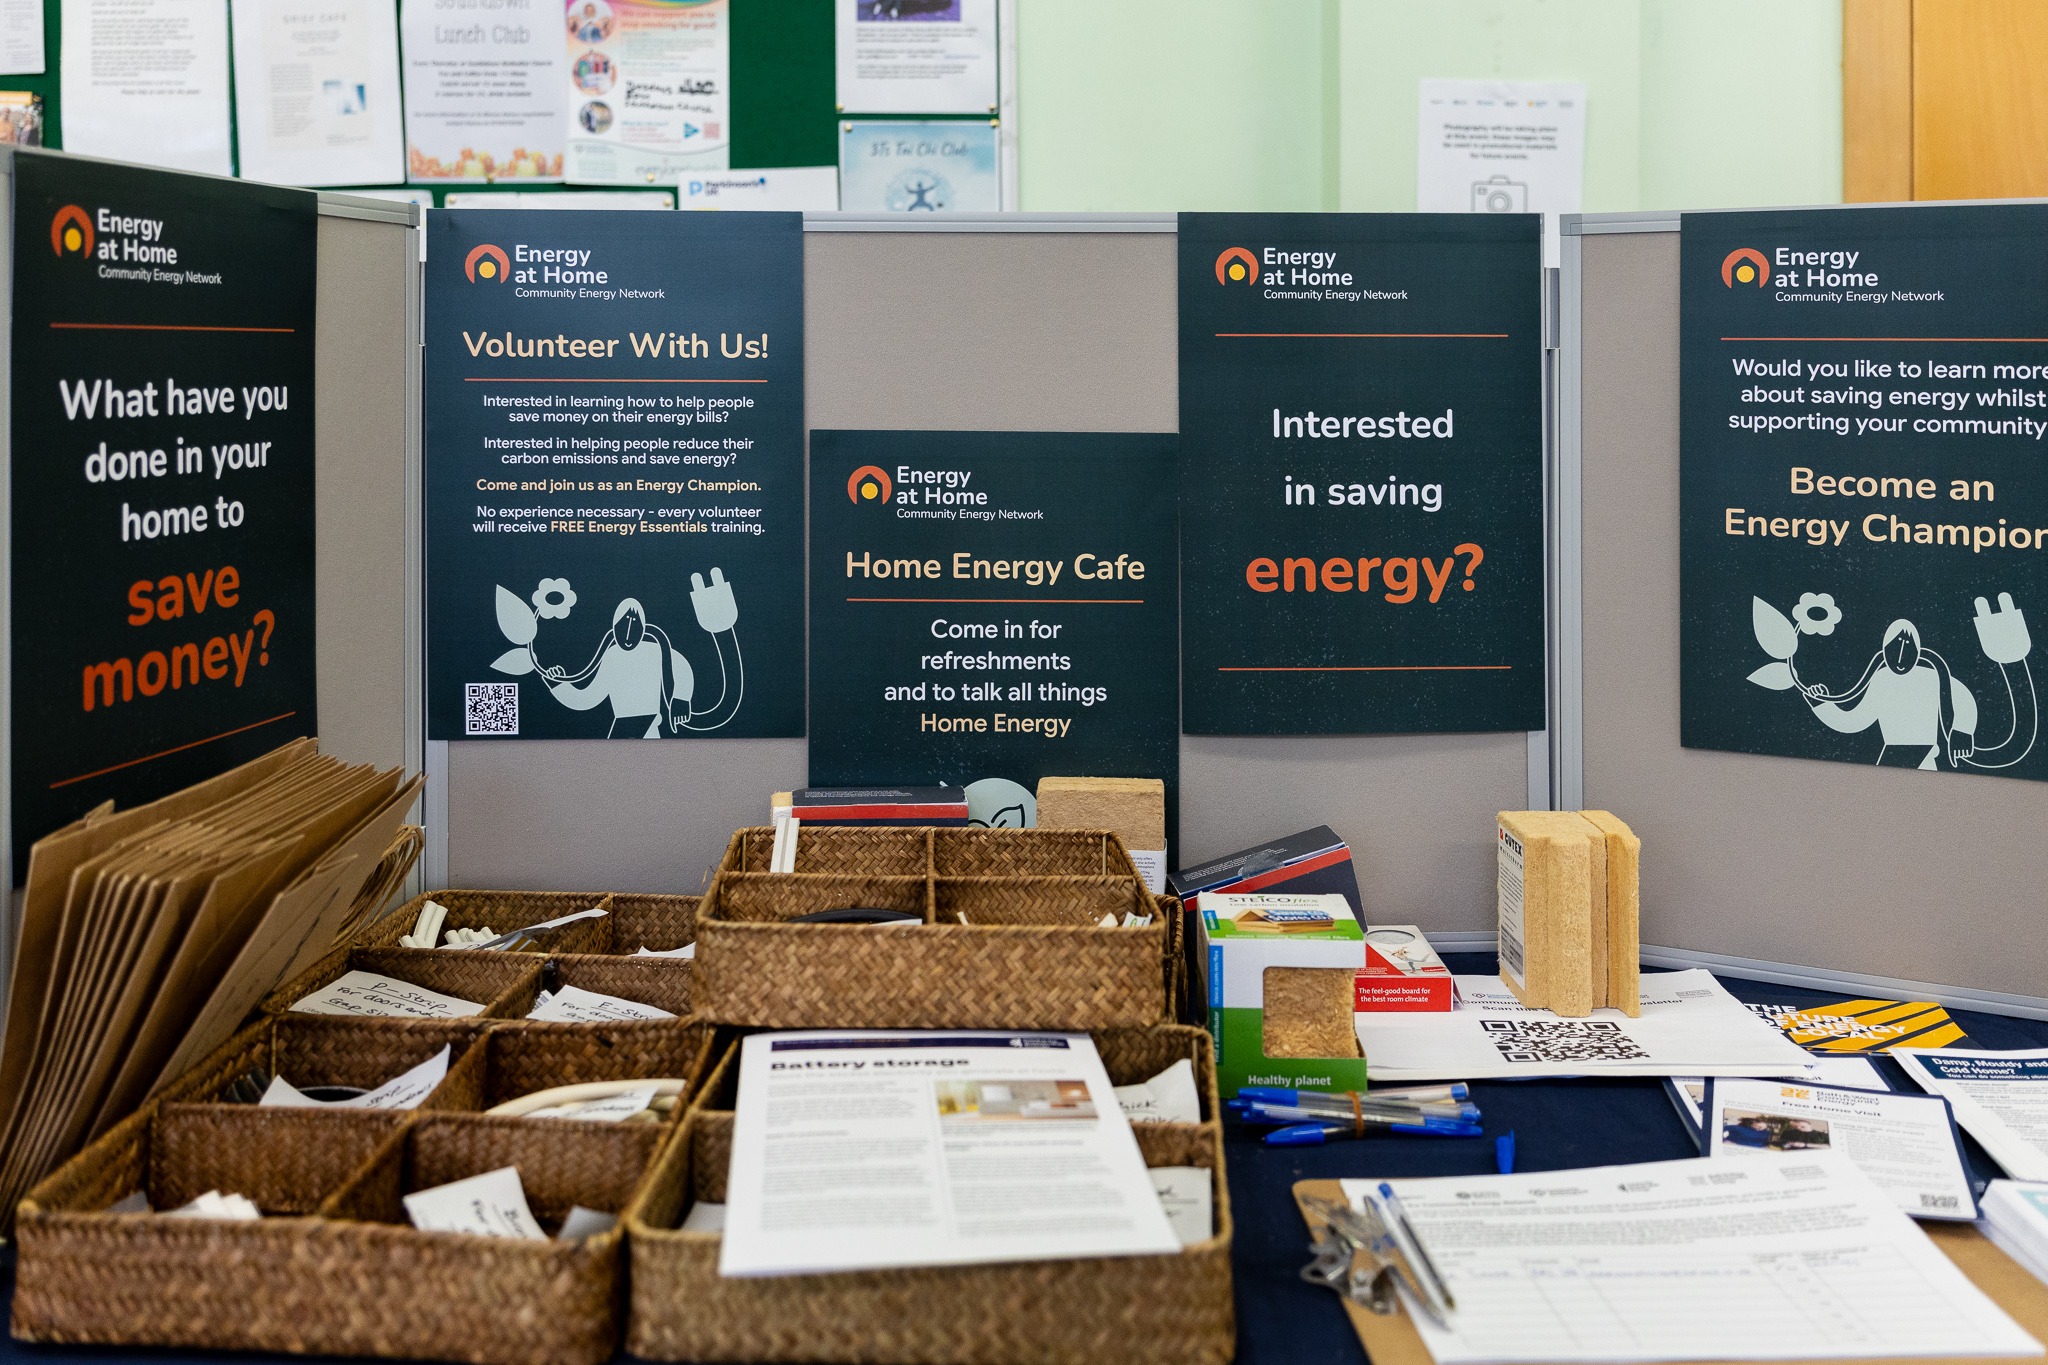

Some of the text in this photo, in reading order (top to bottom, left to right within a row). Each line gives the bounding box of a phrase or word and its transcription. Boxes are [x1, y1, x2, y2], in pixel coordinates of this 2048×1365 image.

[435, 24, 531, 45] Lunch Club
[98, 208, 163, 241] Energy
[98, 238, 177, 264] at Home
[516, 245, 591, 266] Energy
[1264, 248, 1336, 269] Energy
[1776, 248, 1859, 269] Energy
[98, 265, 221, 284] Community Energy Network
[515, 266, 607, 284] at Home
[1264, 268, 1352, 285] at Home
[1775, 269, 1878, 287] at Home
[516, 288, 665, 300] Community Energy Network
[1264, 290, 1407, 301] Community Energy Network
[1776, 291, 1944, 303] Community Energy Network
[463, 332, 768, 358] Volunteer With Us!
[1732, 359, 2048, 381] Would you like to learn more
[60, 378, 287, 420] What have you
[484, 395, 754, 410] Interested in learning how to help people
[1741, 385, 2046, 410] about saving energy whilst
[509, 411, 729, 425] save money on their energy bills?
[1274, 409, 1453, 438] Interested
[1729, 413, 2047, 440] supporting your community
[485, 437, 754, 452] Interested in helping people reduce their
[85, 437, 271, 482] done in your
[502, 453, 736, 467] carbon emissions and save energy?
[477, 479, 761, 493] Come and join us as an Energy Champion.
[898, 466, 971, 488] Energy
[1791, 467, 1994, 501] Become an
[897, 487, 987, 505] at Home
[1285, 476, 1442, 512] in saving
[122, 496, 244, 541] home to
[477, 506, 496, 517] No
[499, 505, 574, 521] experience
[577, 508, 645, 521] necessary
[658, 508, 695, 521] every
[698, 506, 762, 518] volunteer
[897, 509, 1043, 521] Community Energy Network
[473, 521, 765, 535] will receive FREE Energy Essentials training.
[1726, 508, 1849, 546] Energy
[847, 552, 1144, 585] Home Energy Cafe
[1246, 543, 1483, 603] energy?
[128, 566, 239, 625] save
[931, 619, 1062, 638] Come in for
[83, 608, 275, 711] money?
[922, 651, 1071, 670] refreshments
[885, 682, 1107, 706] and to talk all things
[922, 714, 1071, 737] Home Energy
[1372, 987, 1400, 996] feel-good
[1743, 1003, 1799, 1014] THE
[1790, 1027, 1885, 1040] LOCAL
[1797, 1021, 1906, 1034] ENERGY
[771, 1058, 970, 1071] Battery storage
[1931, 1058, 1975, 1067] Damp,
[1975, 1060, 2022, 1068] Mouldy
[1971, 1067, 2015, 1075] Home?
[1248, 1075, 1331, 1088] Healthy planet
